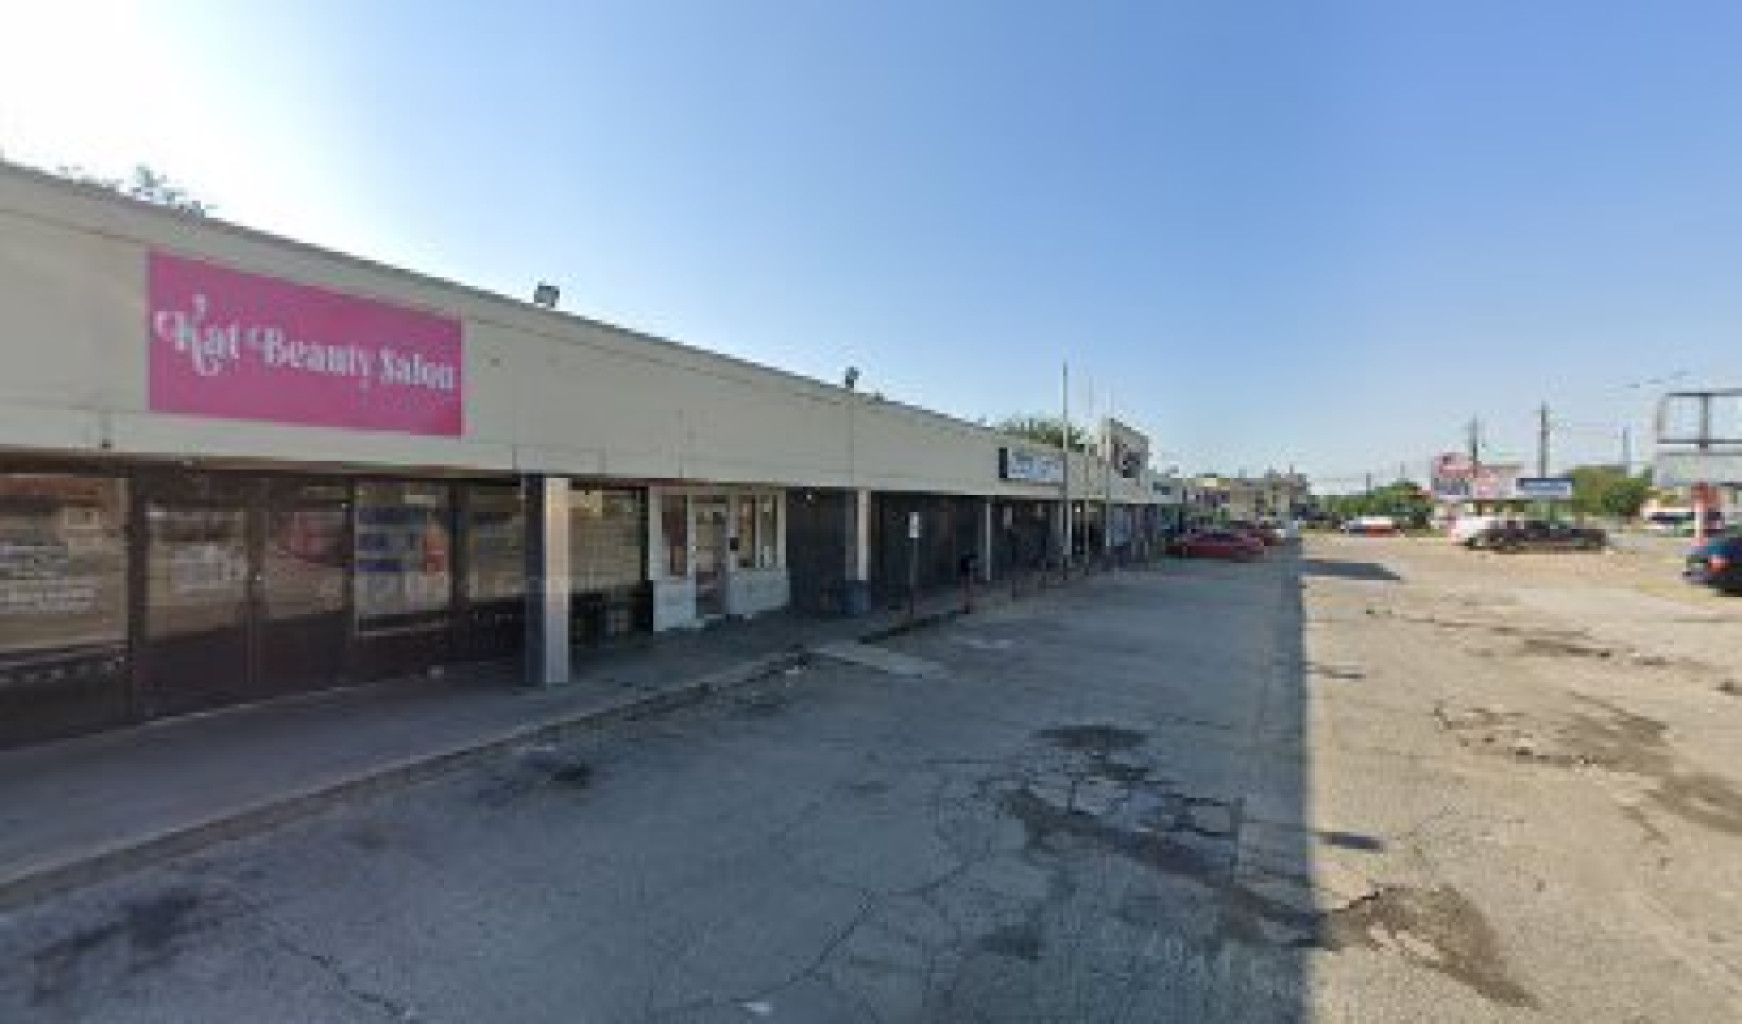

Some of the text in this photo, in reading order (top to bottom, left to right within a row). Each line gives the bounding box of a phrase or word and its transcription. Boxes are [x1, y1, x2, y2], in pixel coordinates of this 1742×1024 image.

[153, 293, 455, 392] Kat Beauty Salon
